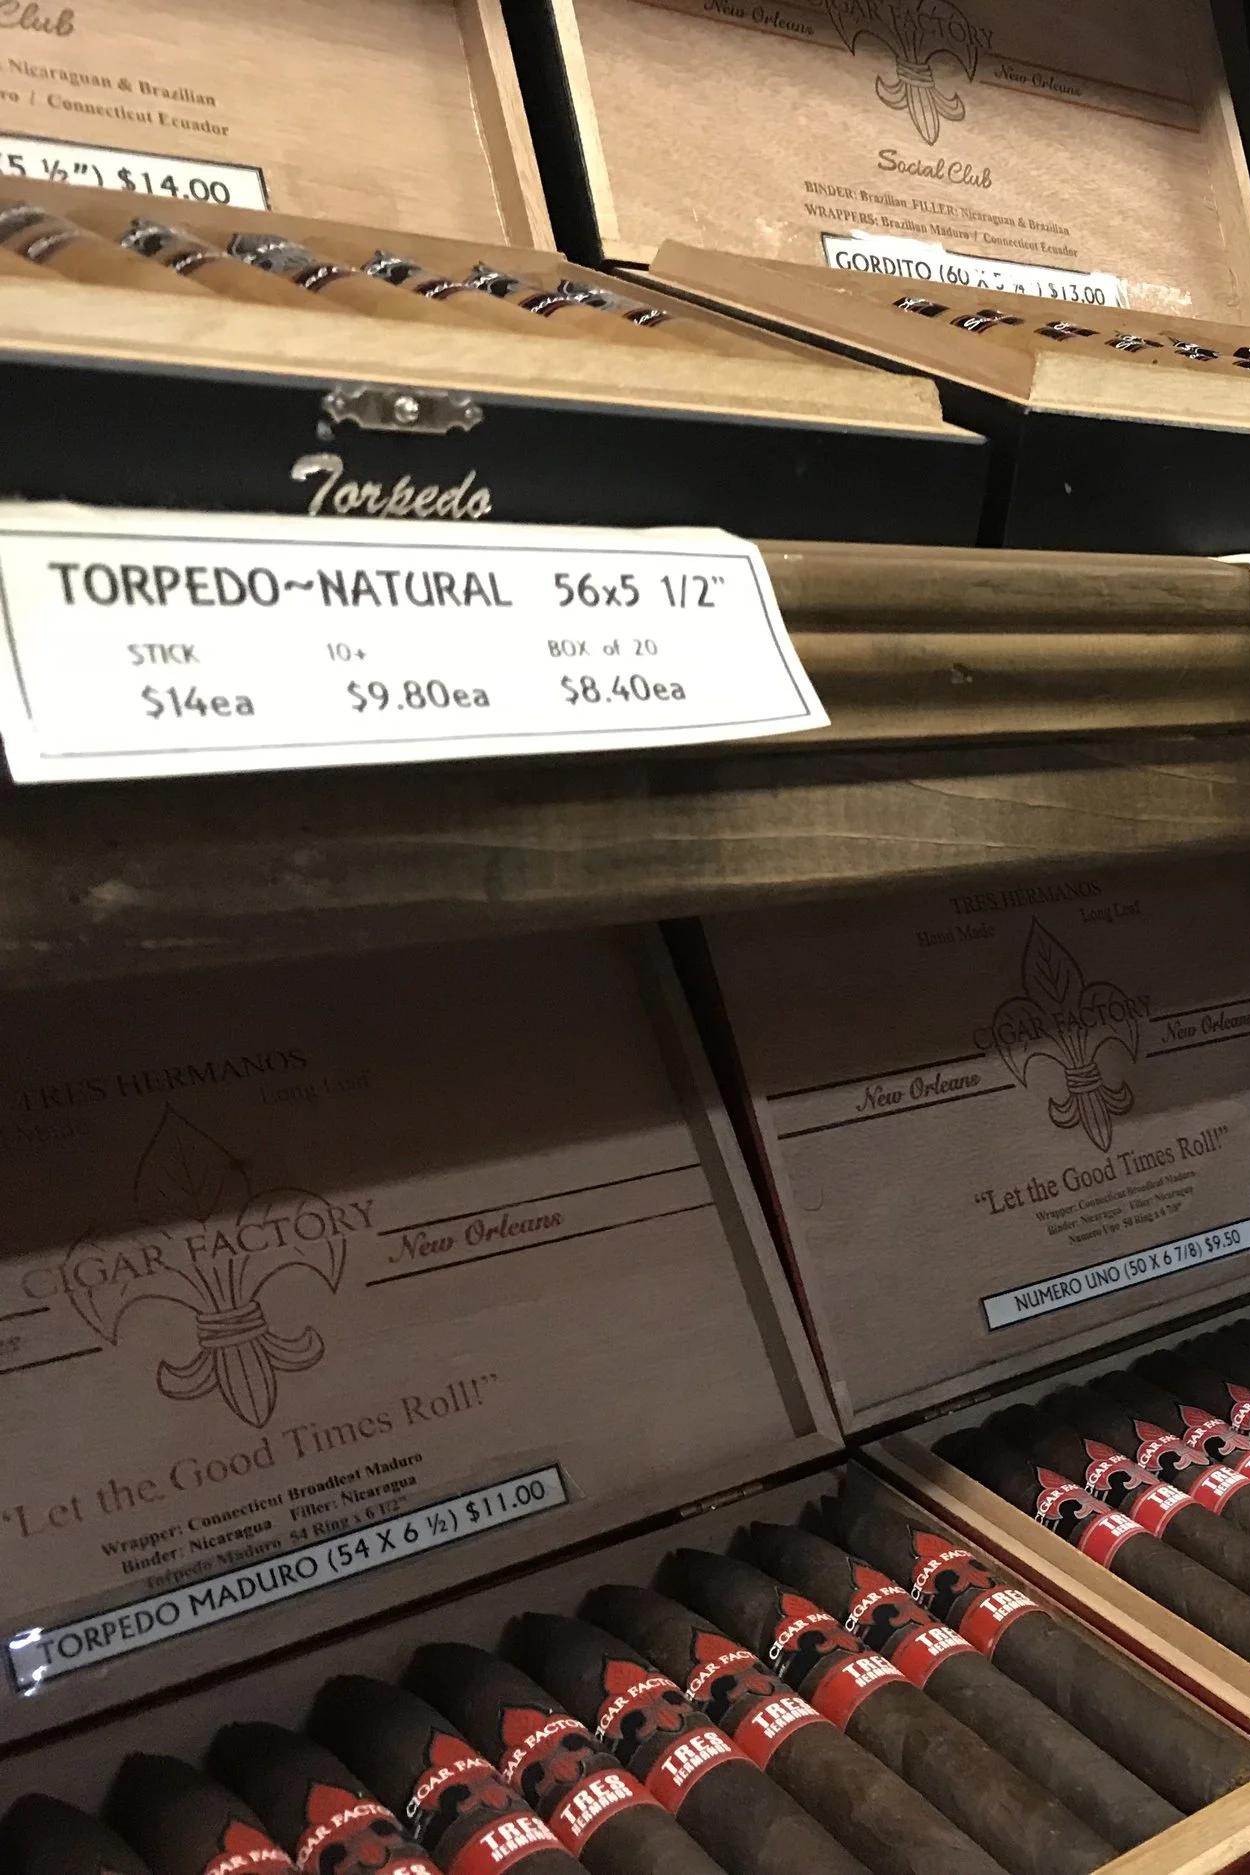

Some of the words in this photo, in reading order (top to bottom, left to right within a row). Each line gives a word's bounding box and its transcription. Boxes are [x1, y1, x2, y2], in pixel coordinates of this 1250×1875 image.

[751, 5, 816, 36] Orleans
[887, 4, 994, 50] FACTORY
[8, 57, 112, 91] Nicaraguan
[138, 79, 217, 108] Brazilian
[994, 63, 1027, 83] New
[1030, 73, 1082, 97] Orleans
[47, 93, 153, 123] Connecticut
[158, 111, 229, 137] Ecuador
[118, 166, 231, 205] $14.00
[877, 148, 944, 180] Social
[947, 160, 993, 189] Club
[804, 180, 858, 201] BINDER:
[860, 190, 907, 209] Brazilian
[912, 198, 959, 218] FILLER:
[960, 206, 1015, 228] Nicaraguan
[1028, 218, 1070, 236] Brazilian
[804, 203, 878, 227] WRAPPERS:
[880, 215, 928, 234] Brazilian
[930, 223, 970, 242] Maduro
[983, 232, 1039, 252] Connecticut
[836, 250, 931, 280] GORDITO
[289, 452, 494, 517] Torpedo
[49, 560, 513, 610] TORPEDO~NATURAL
[553, 573, 641, 609] 56x5
[127, 642, 199, 667] STICK
[326, 642, 367, 663] 10+
[547, 638, 592, 658] BOX
[602, 638, 620, 658] of
[632, 638, 658, 657] 20
[141, 684, 255, 721] $14ea
[346, 679, 490, 714] $9.80ea
[560, 673, 687, 706] $8.40ea
[1000, 880, 1102, 913] HERMANOS
[972, 1015, 1048, 1053] CIGAR
[1051, 994, 1153, 1037] FACTORY
[1161, 1021, 1198, 1045] New
[115, 1047, 309, 1098] HERMANOS
[855, 1083, 905, 1115] New
[908, 1070, 983, 1105] Orleans
[1027, 1178, 1060, 1206] the
[1061, 1155, 1117, 1192] Good
[1116, 1144, 1177, 1175] Times
[21, 1245, 168, 1300] CIGAR
[185, 1199, 378, 1264] FACTORY
[388, 1231, 456, 1265] New
[463, 1209, 566, 1250] Orleans
[1014, 1276, 1083, 1313] NUMERO
[1084, 1264, 1122, 1292] UNO
[1122, 1254, 1147, 1281] (50
[1149, 1252, 1161, 1271] X
[1162, 1249, 1173, 1267] 6
[1173, 1241, 1204, 1265] 7/8)
[1205, 1228, 1242, 1254] $9.50
[95, 1474, 167, 1511] the
[169, 1435, 277, 1491] Good
[281, 1409, 394, 1462] Times
[101, 1521, 184, 1558] Wrapper:
[187, 1492, 284, 1533] Connecticut
[364, 1451, 424, 1479] Maduro
[121, 1545, 184, 1575] Binder:
[188, 1517, 274, 1552] Nicaragua
[289, 1498, 339, 1523] Filler:
[339, 1473, 419, 1505] Nicaragua
[38, 1600, 181, 1666] TORPEDO
[187, 1554, 319, 1617] MADURO
[327, 1537, 371, 1574] (54
[379, 1528, 398, 1555] X
[402, 1519, 420, 1545] 6
[464, 1478, 547, 1526] $11.00
[910, 1559, 943, 1600] CIGAR
[845, 1591, 883, 1633] CIGAR
[769, 1618, 810, 1661] CIGAR
[661, 1731, 720, 1777] TRES
[406, 1766, 455, 1818] CIGAR
[560, 1773, 627, 1826] TRES
